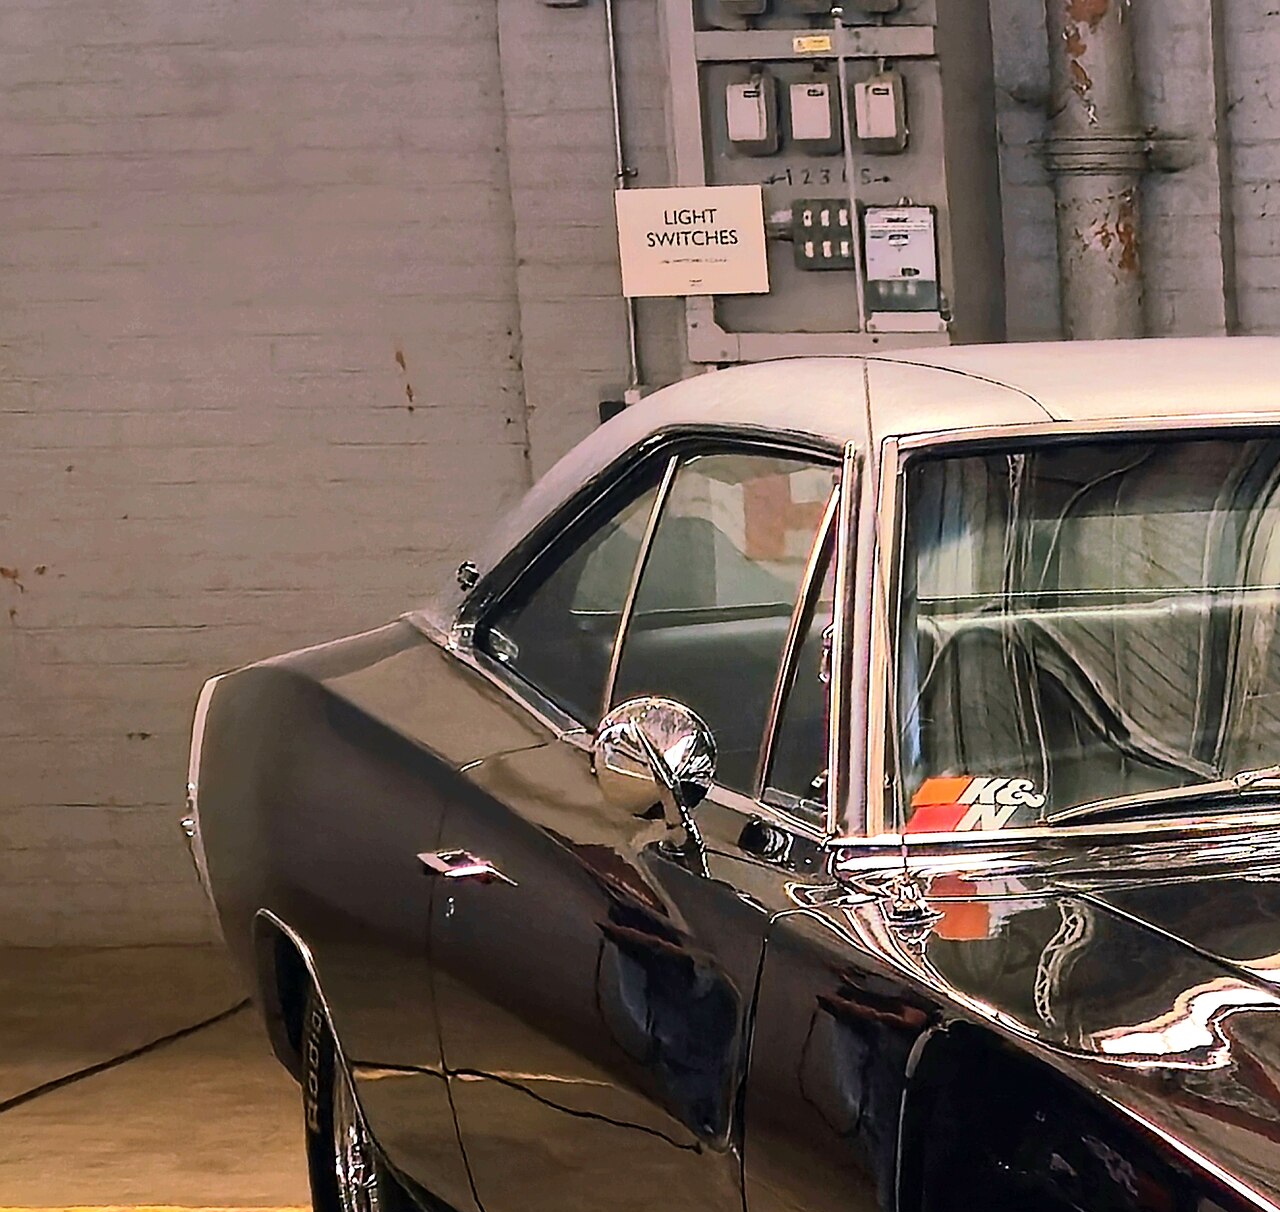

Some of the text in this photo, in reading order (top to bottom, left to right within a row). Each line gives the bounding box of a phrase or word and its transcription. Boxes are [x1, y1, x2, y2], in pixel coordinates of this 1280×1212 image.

[802, 169, 813, 185] 2
[820, 169, 831, 184] 3
[664, 208, 718, 225] LIGHT
[646, 229, 739, 248] SWITCHES
